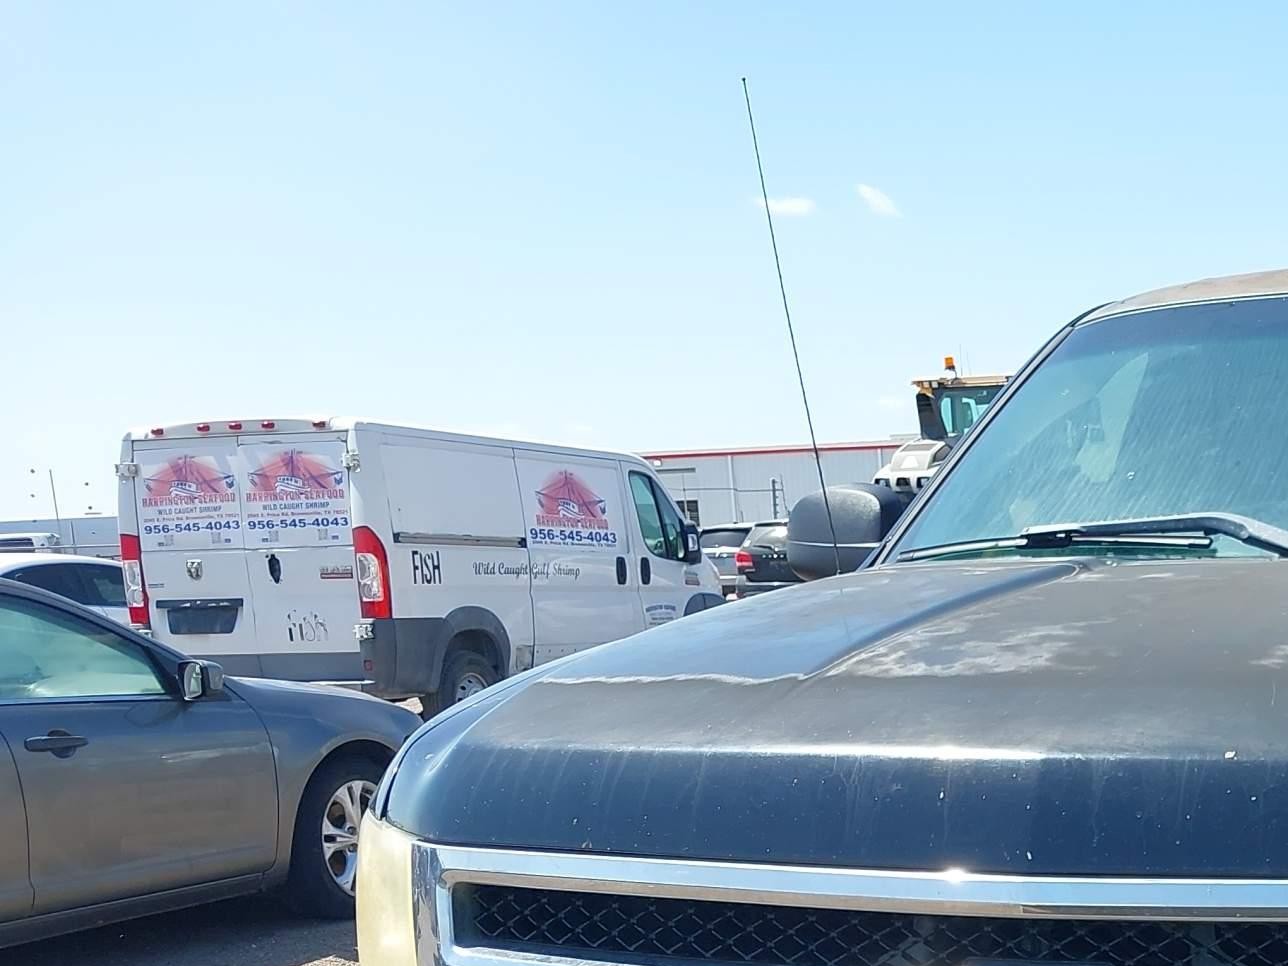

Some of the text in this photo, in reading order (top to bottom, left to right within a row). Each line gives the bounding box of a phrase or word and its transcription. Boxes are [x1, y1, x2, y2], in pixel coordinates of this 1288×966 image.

[198, 492, 236, 504] SEAFOOD
[304, 488, 345, 500] SEAFOOD
[199, 505, 222, 513] SHRIMP
[305, 501, 330, 509] SHRIMP
[144, 520, 241, 535] 956-545-4043
[247, 517, 349, 530] 956-545-4043
[529, 527, 617, 543] 956-545-4043
[411, 550, 442, 585] FISH
[472, 562, 580, 581] Wild Caught Gulf Shrimp
